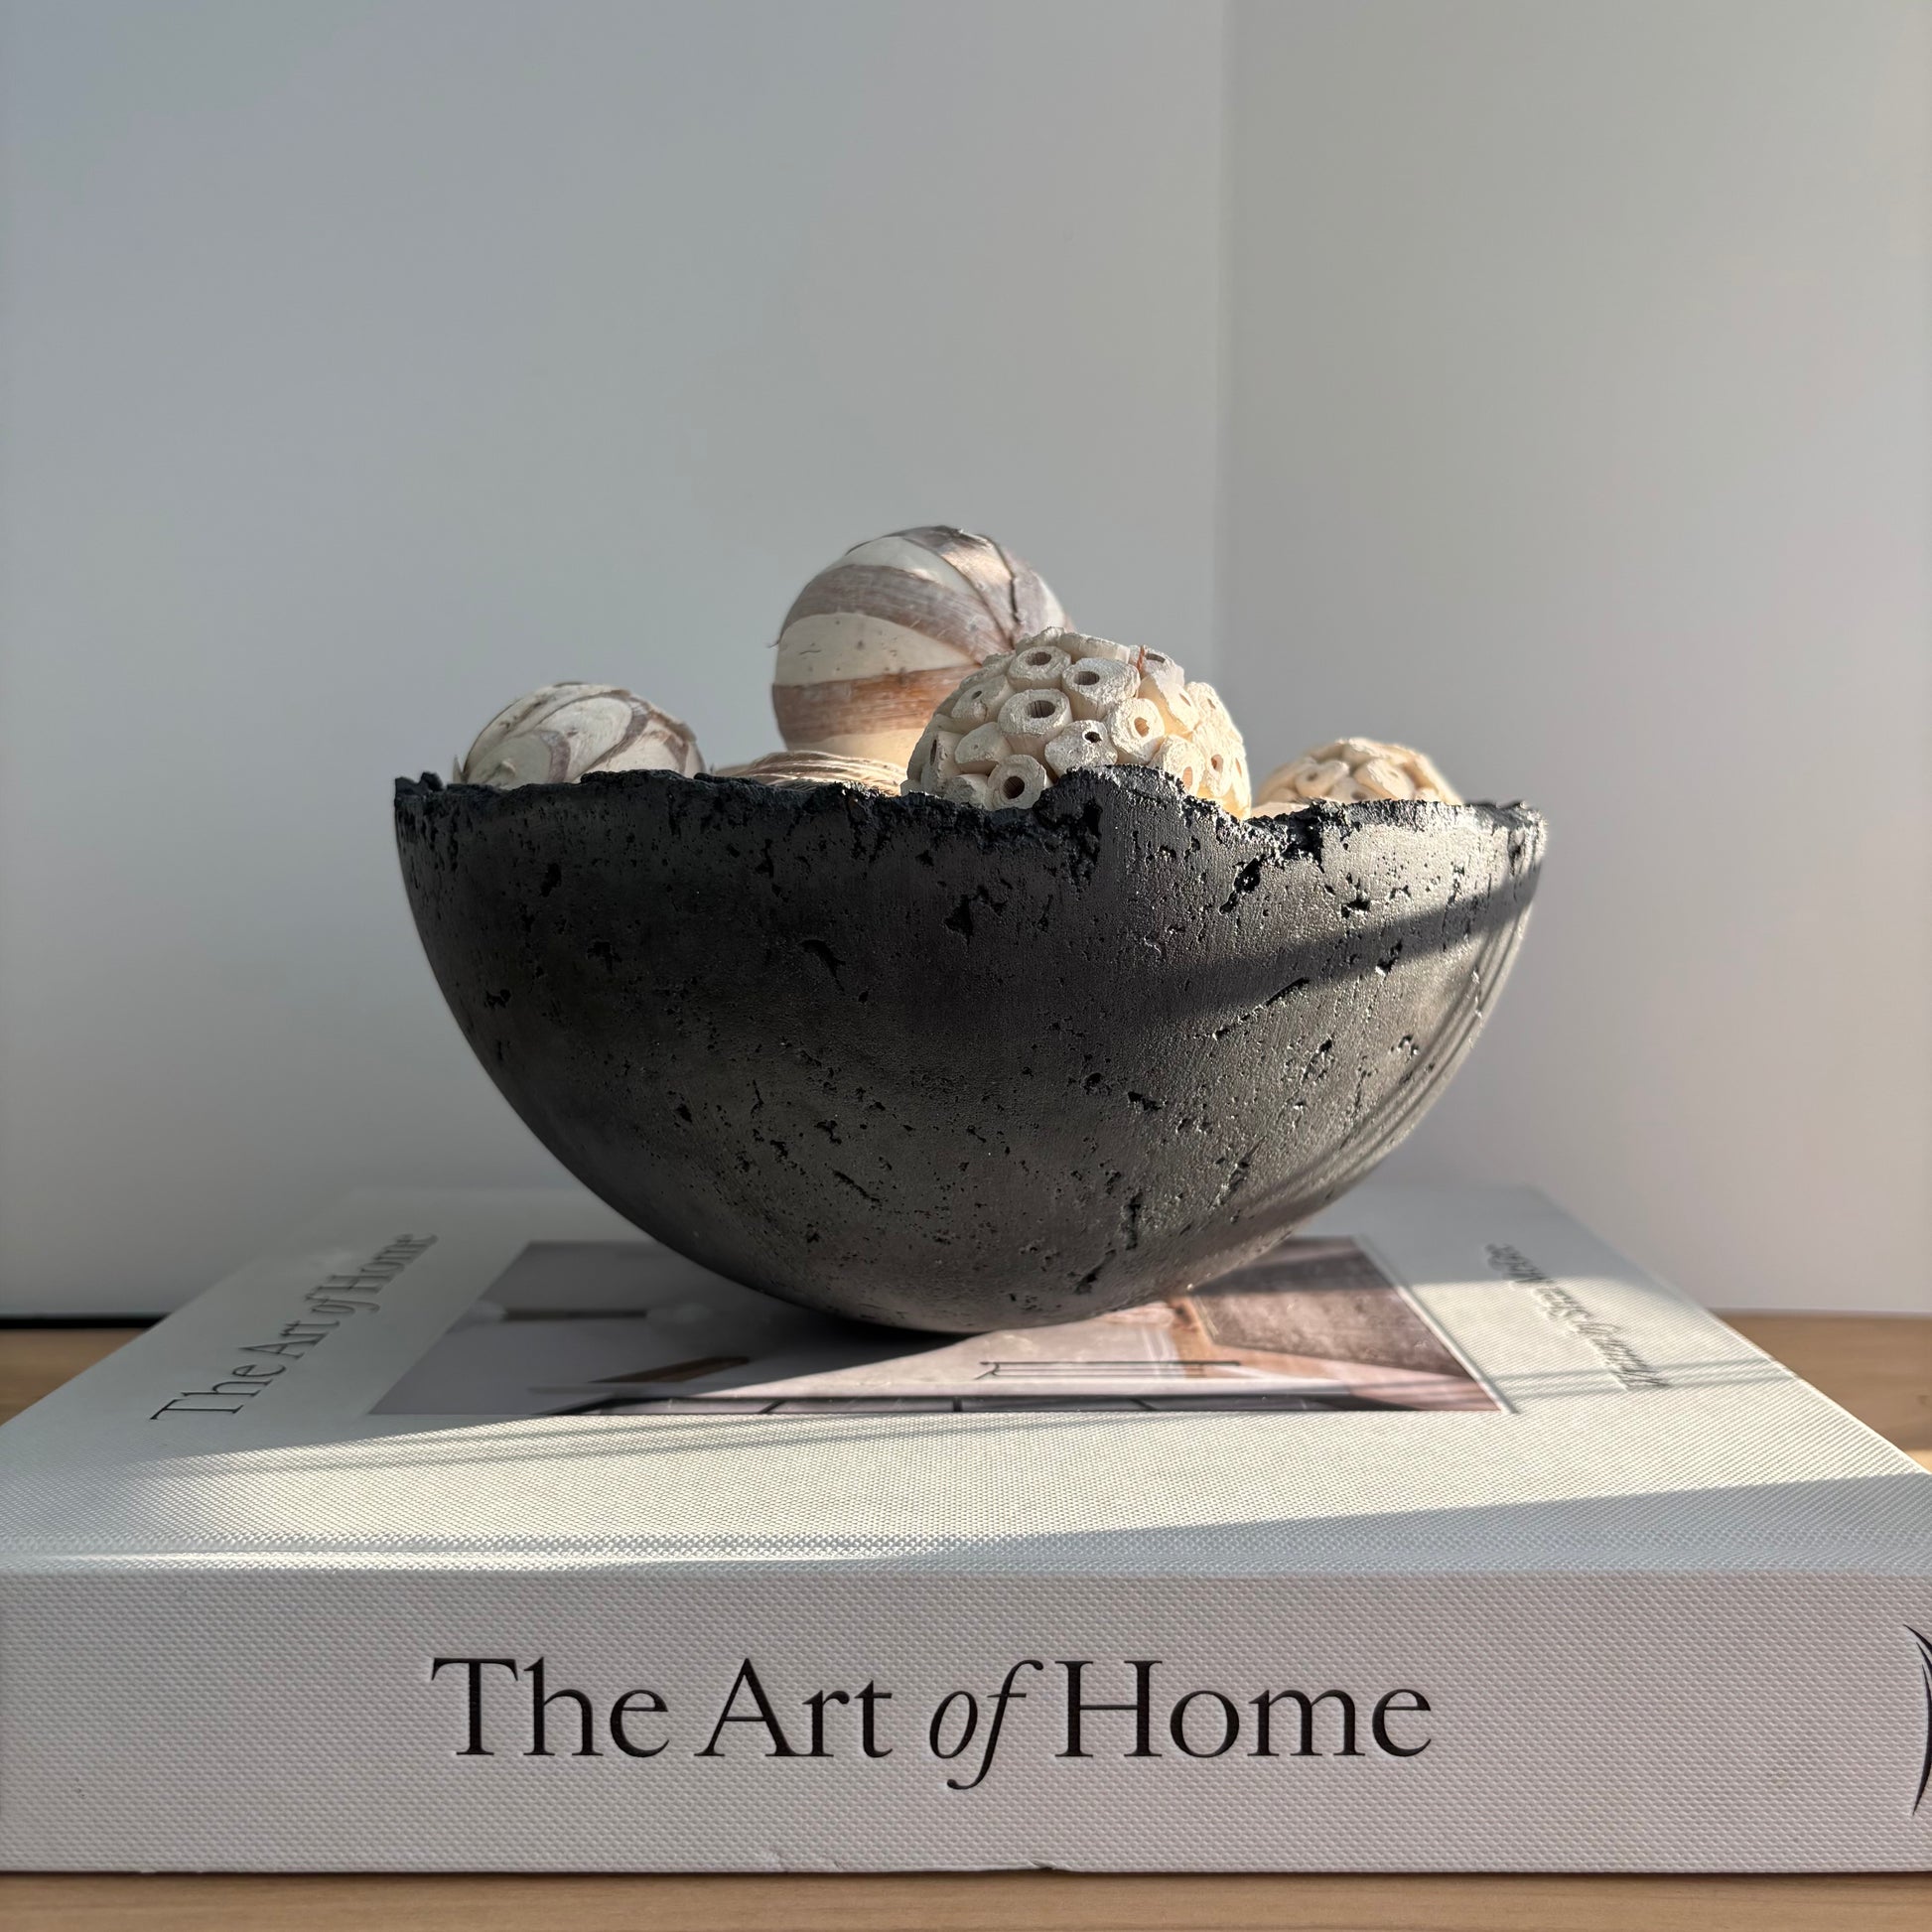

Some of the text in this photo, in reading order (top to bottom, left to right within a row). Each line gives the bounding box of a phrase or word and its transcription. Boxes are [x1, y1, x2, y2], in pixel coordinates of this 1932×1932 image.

[149, 1234, 439, 1421] The Art of Home
[431, 1656, 1433, 1791] The Art of Home
